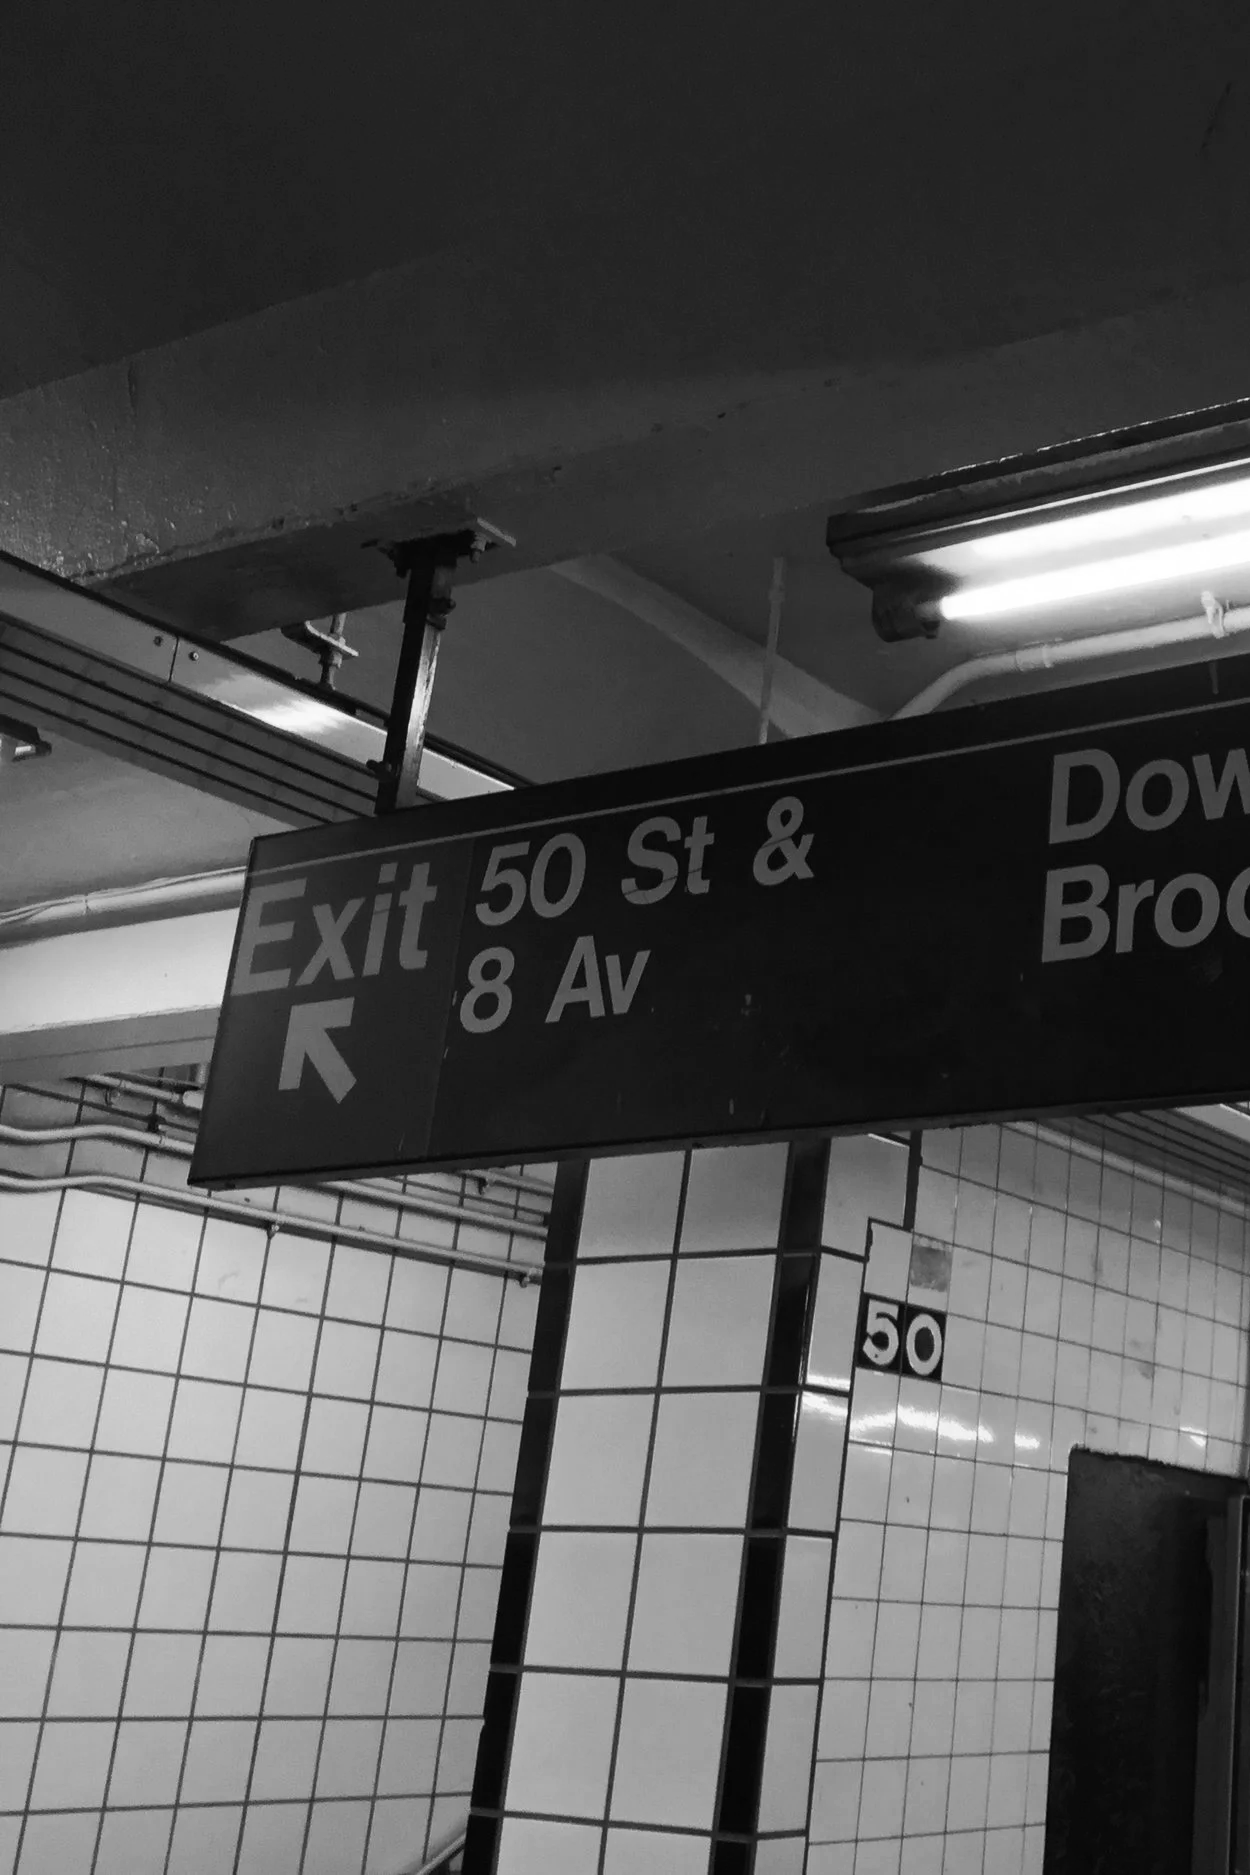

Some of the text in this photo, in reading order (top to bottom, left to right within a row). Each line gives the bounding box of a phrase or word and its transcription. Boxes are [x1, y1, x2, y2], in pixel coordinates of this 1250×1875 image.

[475, 795, 816, 927] 50 St &
[230, 861, 438, 997] Exit
[459, 935, 652, 1034] 8 Av
[862, 1300, 942, 1377] 50
